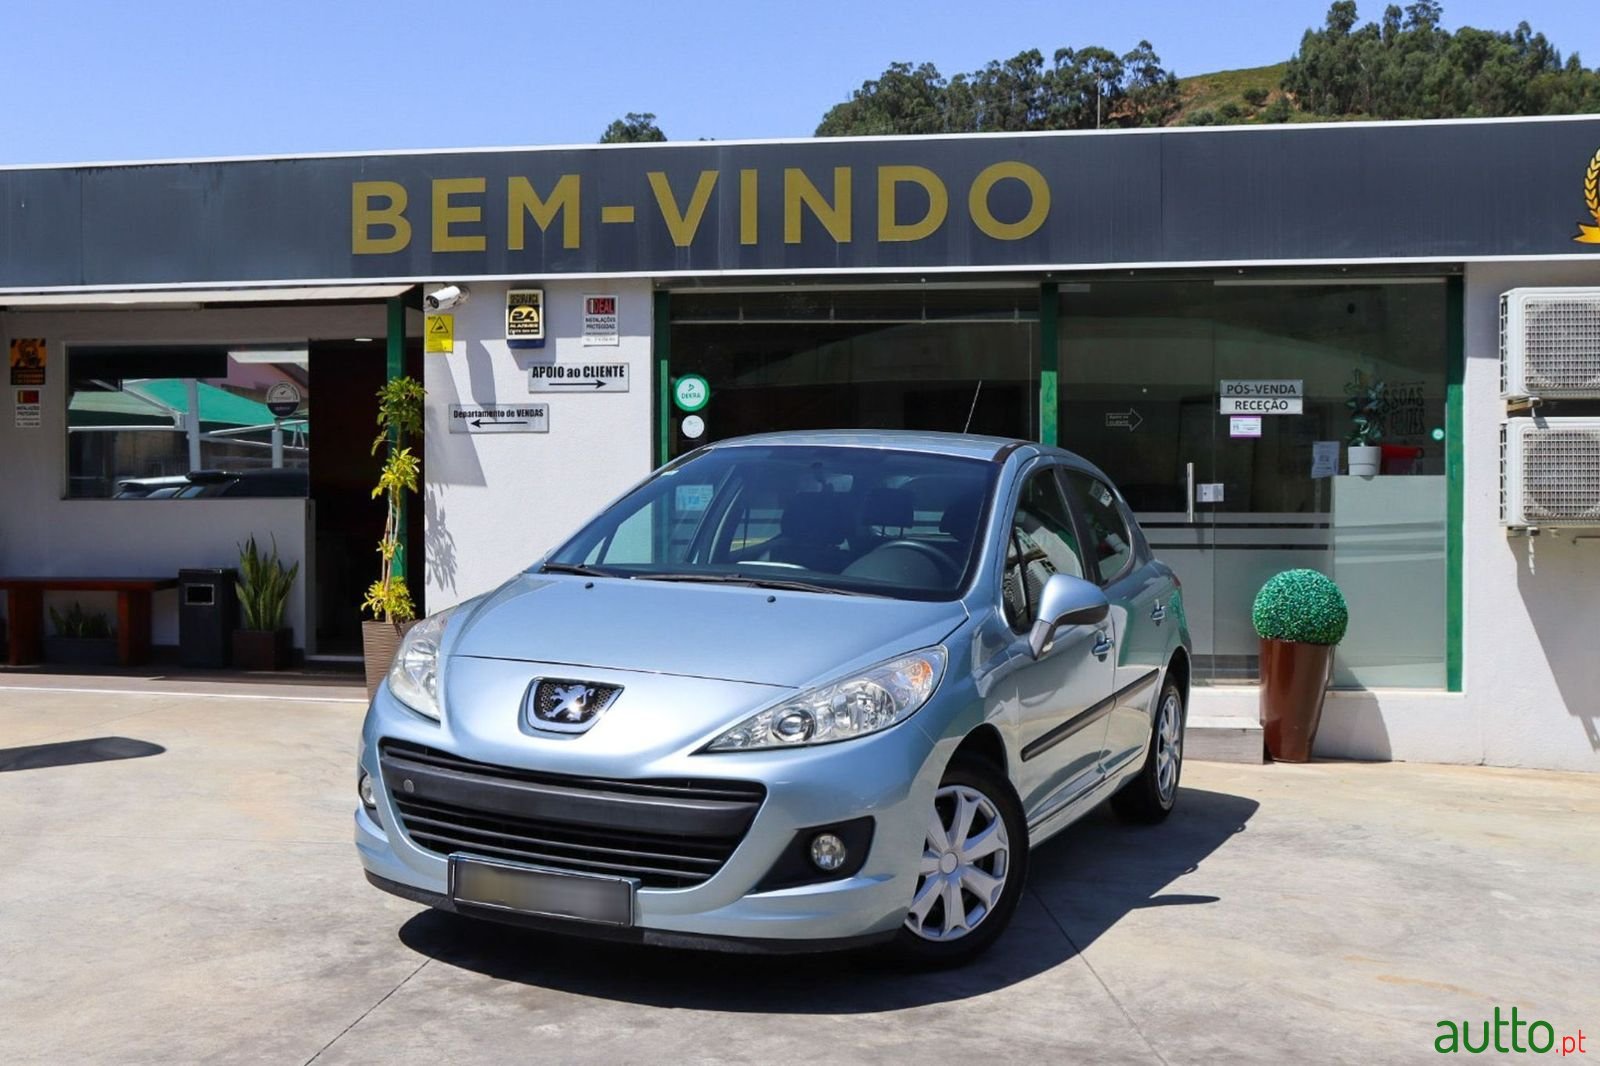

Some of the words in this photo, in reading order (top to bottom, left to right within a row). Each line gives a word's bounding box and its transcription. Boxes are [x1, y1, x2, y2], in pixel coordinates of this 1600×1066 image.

[351, 161, 1051, 254] BEM-VINDO
[512, 310, 535, 322] 24
[532, 365, 565, 378] APOIO
[566, 367, 580, 378] ao
[583, 365, 625, 378] CLIENTE
[1226, 382, 1297, 395] PÓS-VENDA
[1234, 398, 1289, 412] RECEÇÃO
[453, 409, 505, 419] Departamento
[506, 409, 516, 418] de
[516, 408, 544, 418] VENDAS
